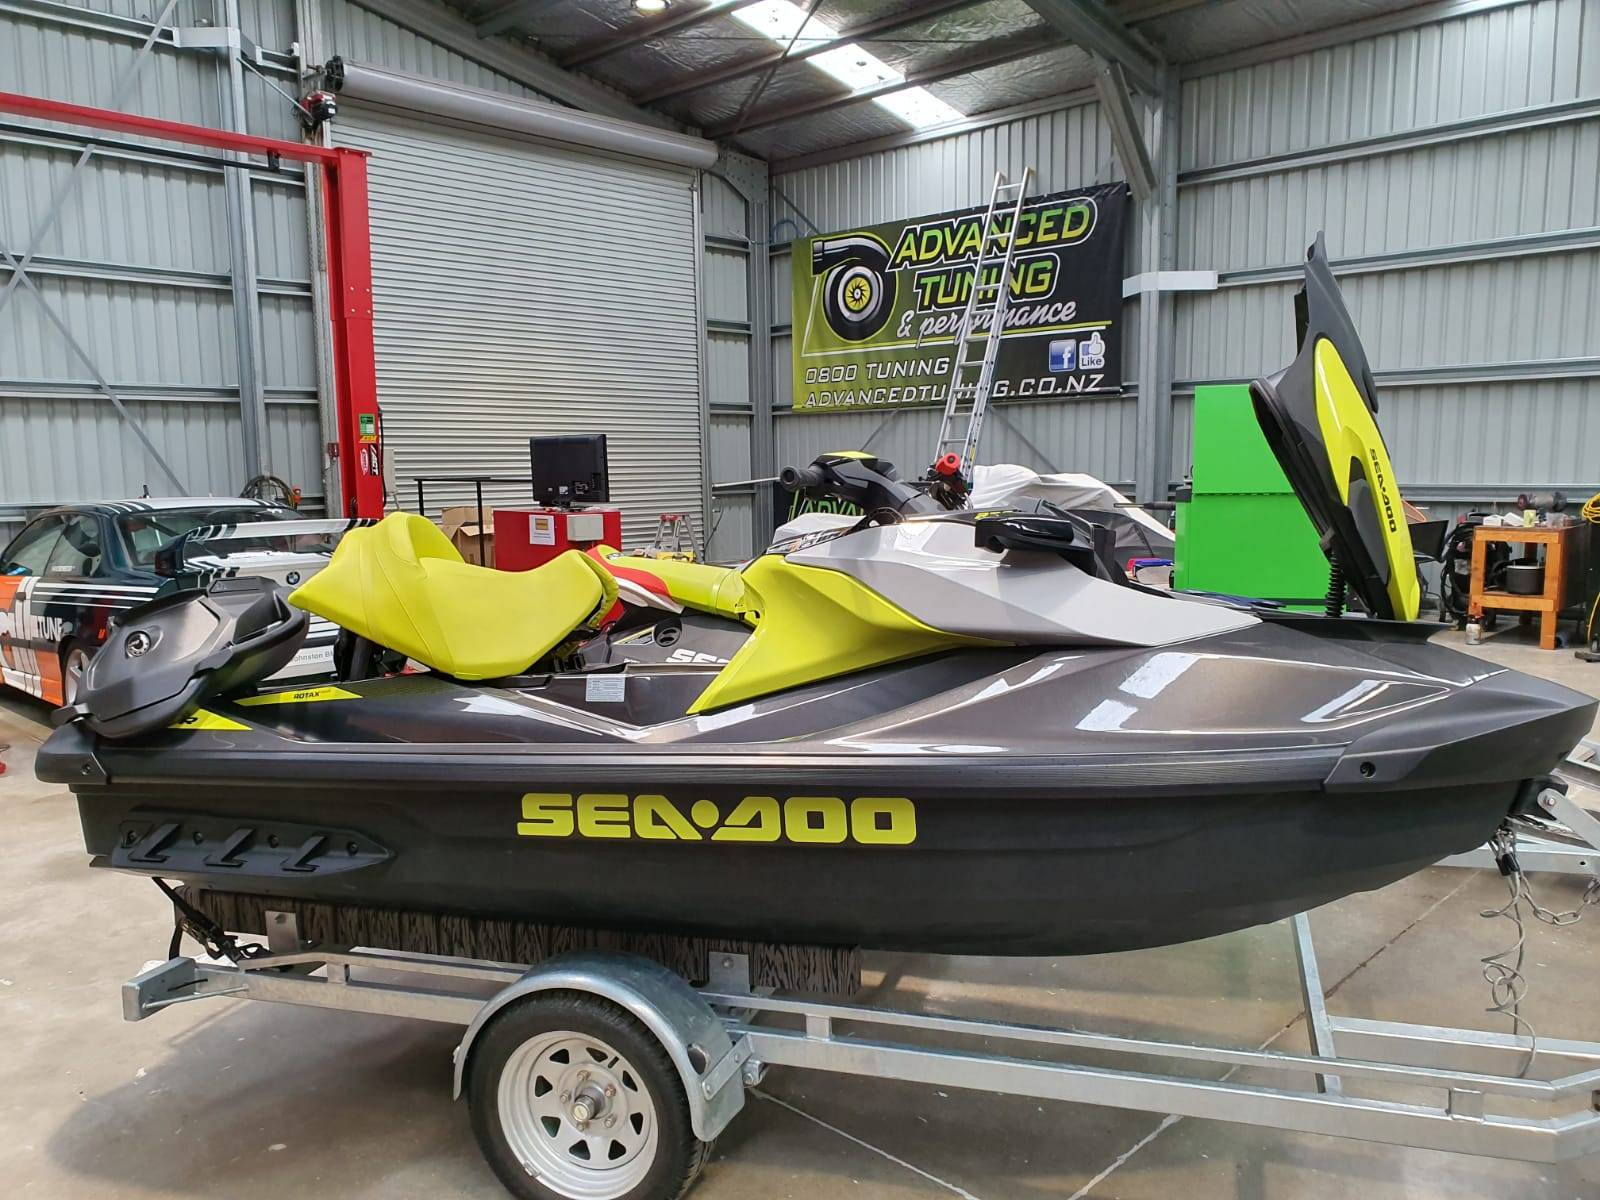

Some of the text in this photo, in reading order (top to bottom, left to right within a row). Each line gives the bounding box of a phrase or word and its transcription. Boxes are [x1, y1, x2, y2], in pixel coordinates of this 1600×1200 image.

[895, 205, 1090, 264] ADVANCED
[897, 310, 915, 338] &
[805, 357, 950, 384] 0800 TUNING
[1081, 358, 1103, 367] Like
[805, 373, 1105, 408] ADVANCEDTUIG.CO.NZ
